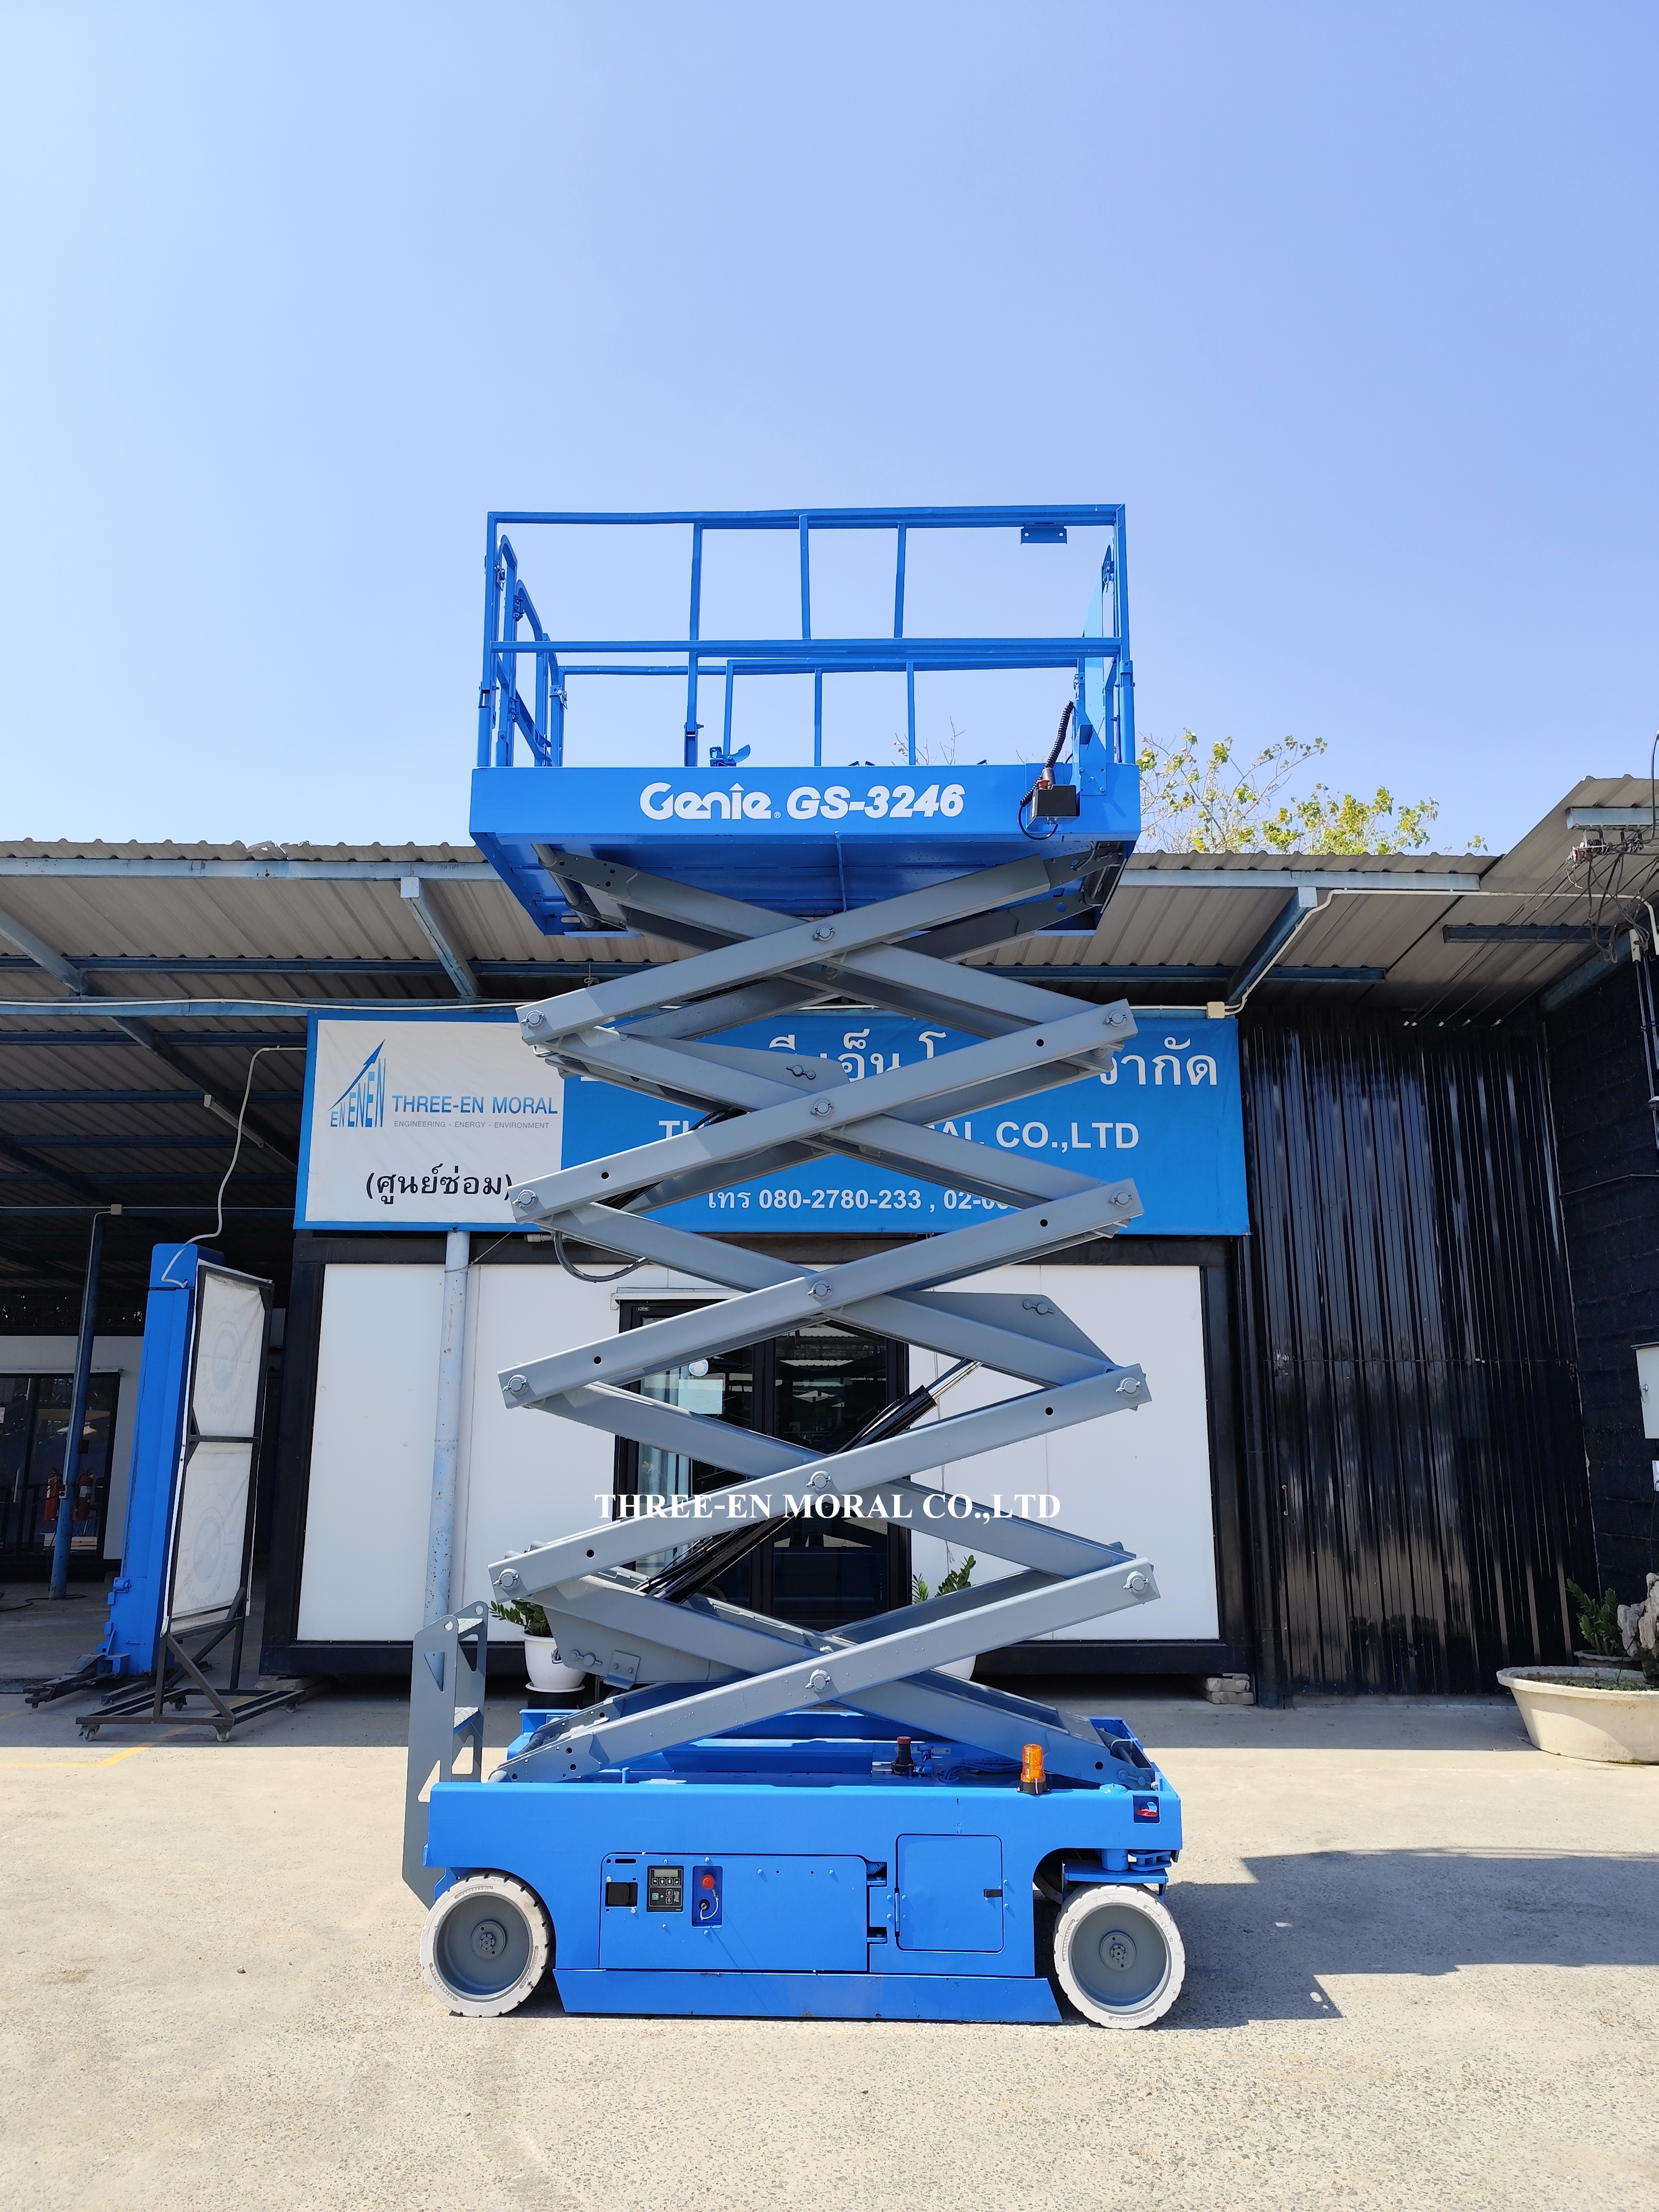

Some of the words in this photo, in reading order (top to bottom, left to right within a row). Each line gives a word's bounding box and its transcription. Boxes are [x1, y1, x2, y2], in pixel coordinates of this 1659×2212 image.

[787, 784, 965, 820] GS-3246
[392, 1095, 484, 1113] THREE-EN
[492, 1096, 558, 1114] MORAL
[996, 1121, 1139, 1153] CO.,LTD
[759, 1189, 921, 1209] 080-2780-233
